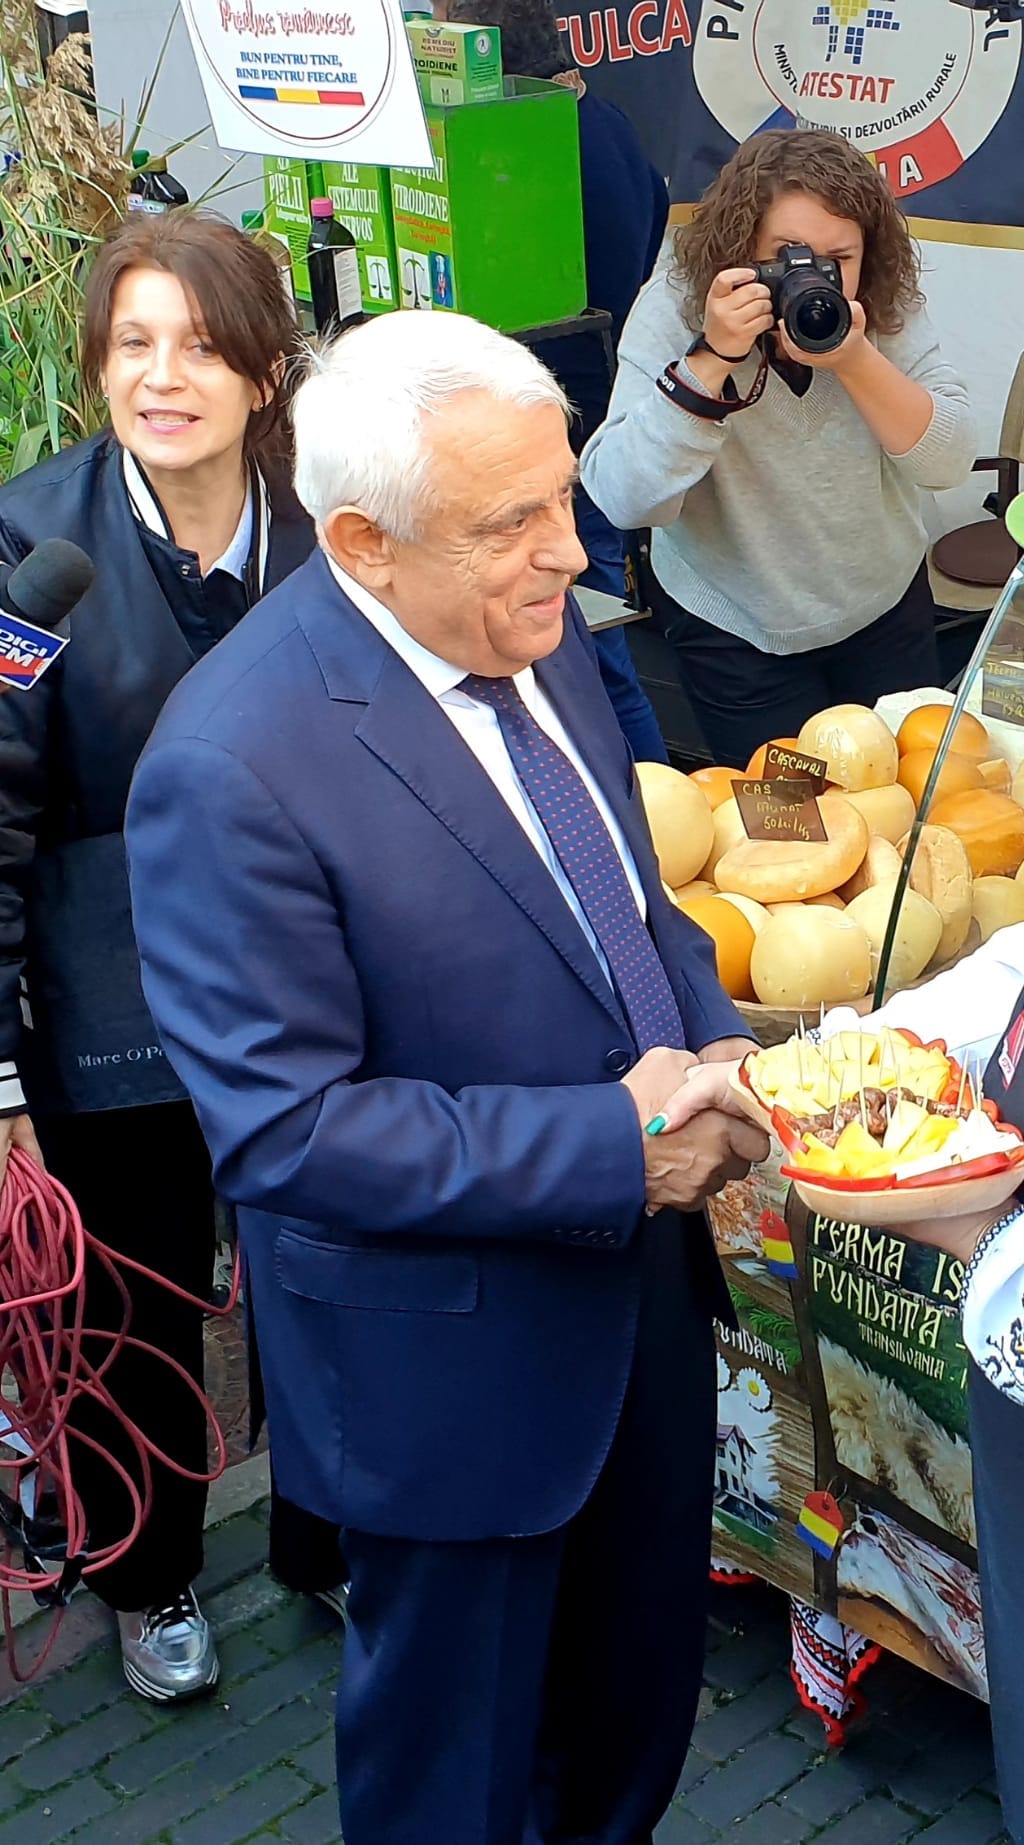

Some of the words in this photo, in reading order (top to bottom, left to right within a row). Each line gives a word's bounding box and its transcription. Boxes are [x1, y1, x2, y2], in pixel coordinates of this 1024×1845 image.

[556, 0, 692, 67] ULCA
[236, 68, 260, 79] BINE
[262, 70, 304, 82] PENTRU
[307, 72, 358, 83] FIECARE
[240, 51, 261, 63] BUN
[264, 53, 308, 65] PENTRU
[309, 55, 343, 67] TINE,
[799, 72, 896, 103] ATESTAT
[855, 100, 928, 138] DEZVOLTĂRII
[926, 52, 957, 102] RURALE
[394, 184, 449, 222] TIROIDIENE
[0, 628, 48, 656] DIGI
[78, 1054, 121, 1068] Marc
[126, 1046, 162, 1061] O'P
[813, 1213, 907, 1281] FERMA
[931, 1253, 966, 1302] IS
[812, 1256, 943, 1349] FUNDATA
[858, 1321, 945, 1381] TRANSILVANIA
